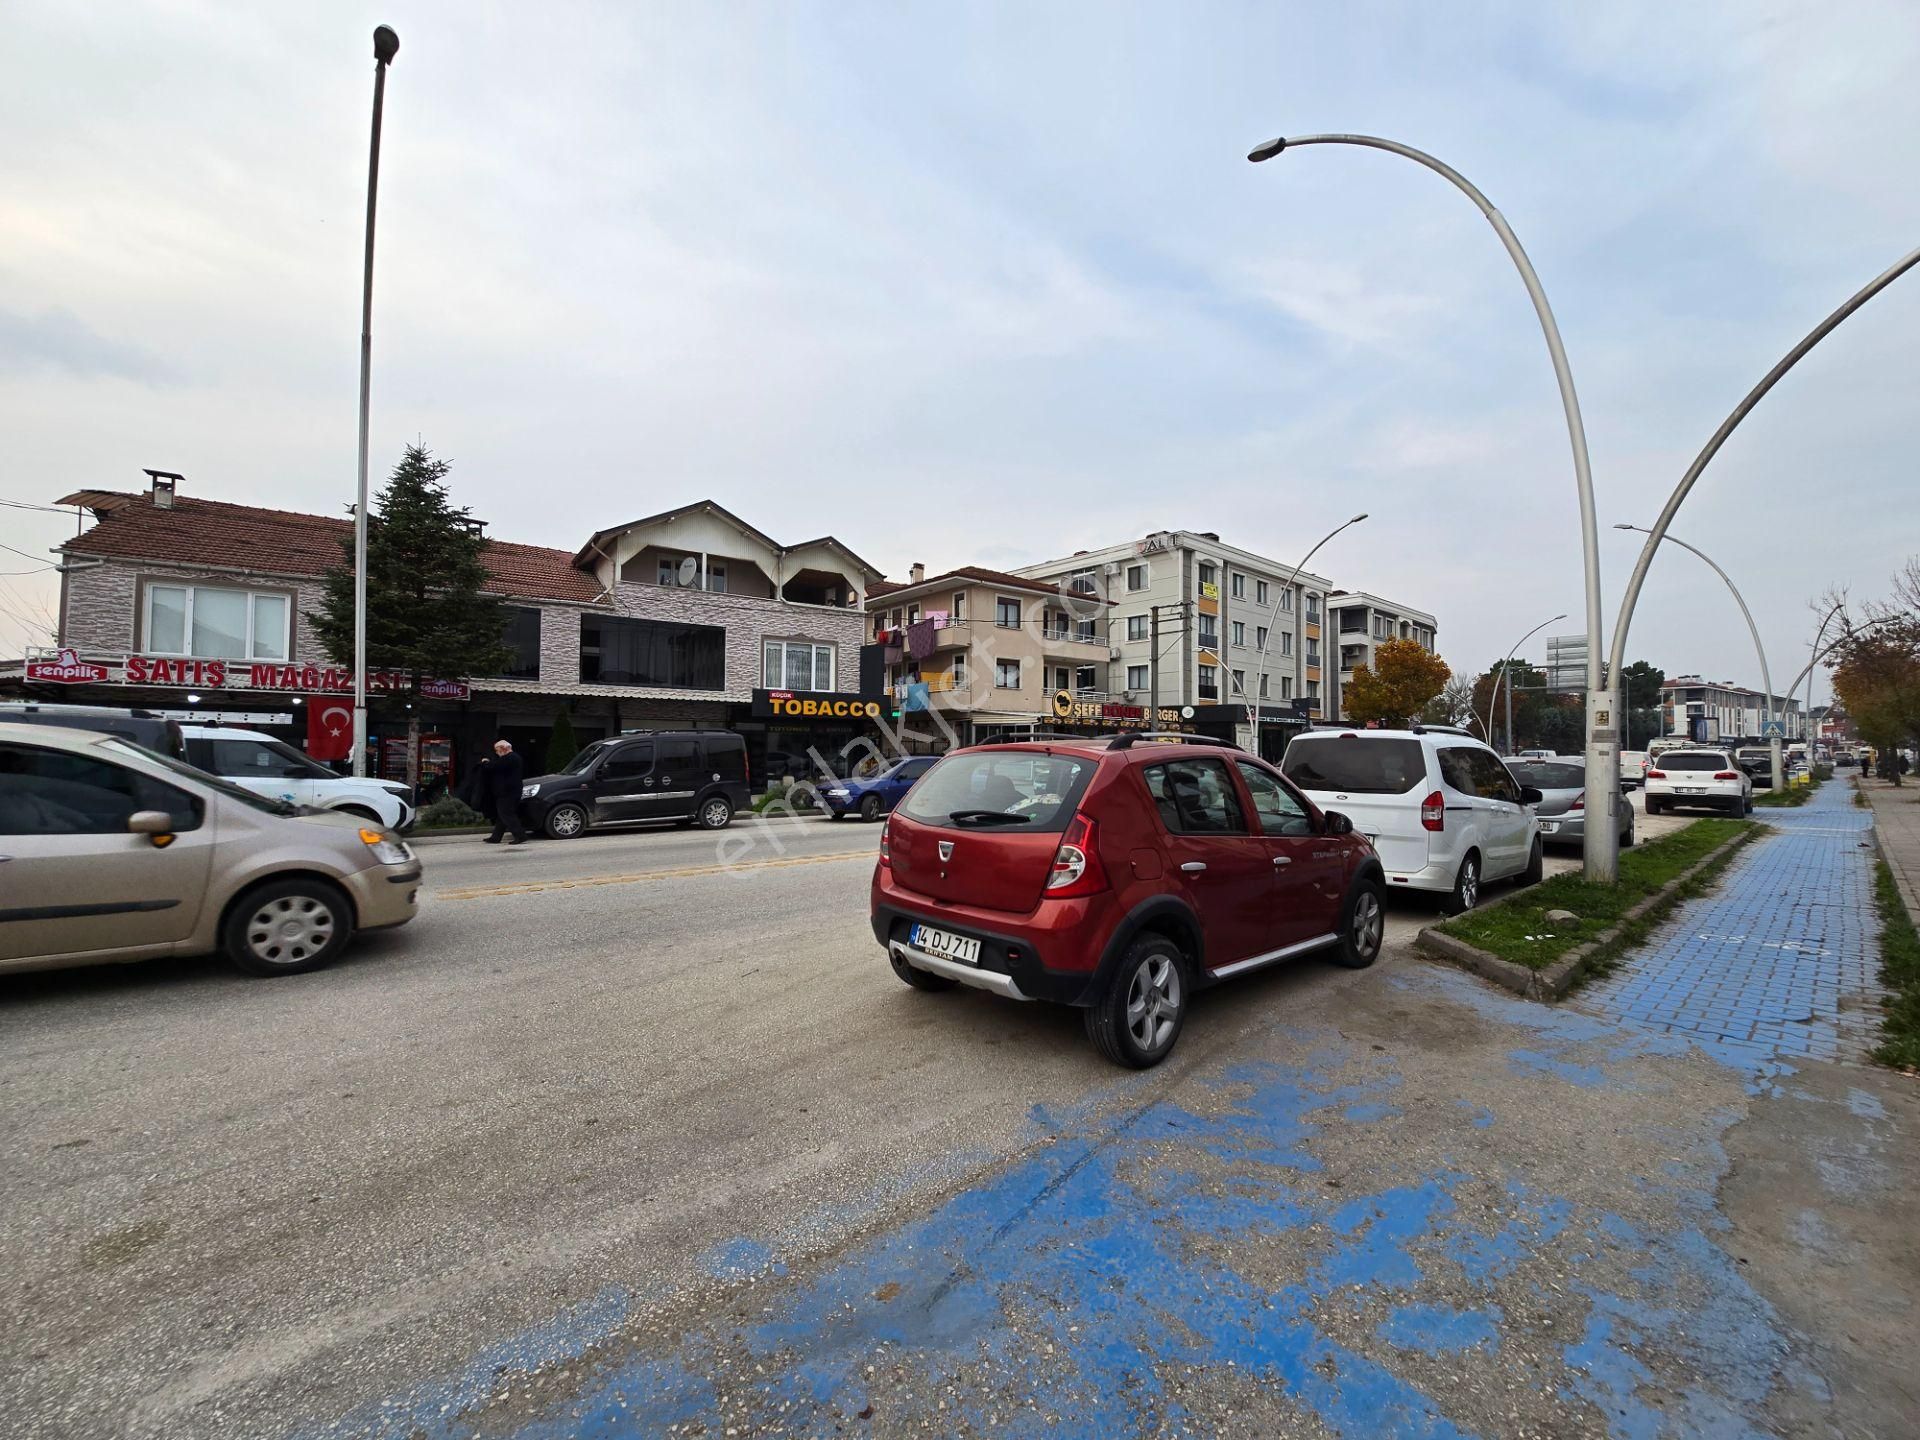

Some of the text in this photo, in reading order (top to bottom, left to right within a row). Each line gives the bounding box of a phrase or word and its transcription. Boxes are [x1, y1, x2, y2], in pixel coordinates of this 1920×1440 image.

[35, 665, 99, 680] şenpiliç
[126, 657, 400, 691] SATIŞ MAĞAZSI
[769, 698, 880, 717] TOBACCO
[1144, 707, 1179, 722] BRGER
[917, 927, 928, 945] 14
[932, 932, 951, 951] DJ
[953, 937, 977, 960] 711
